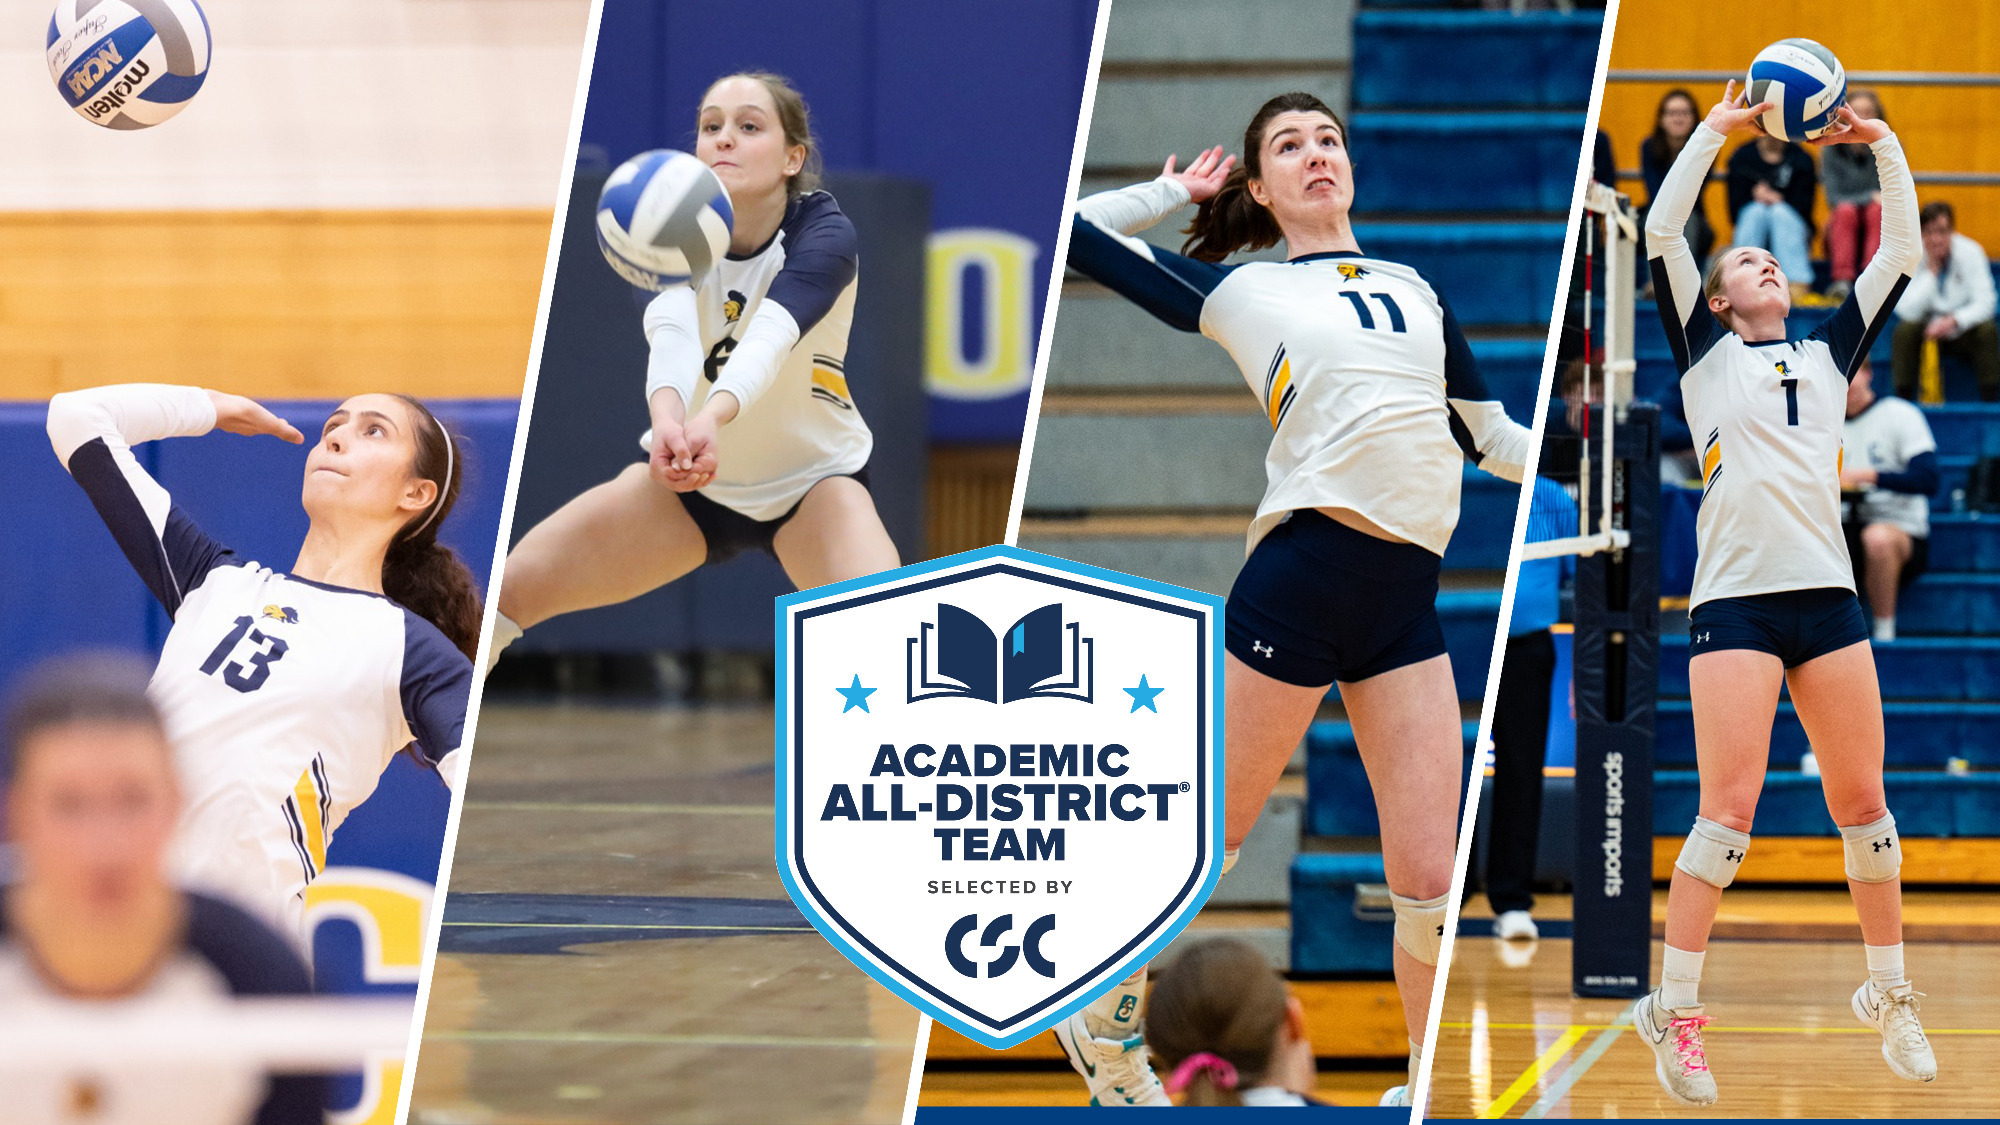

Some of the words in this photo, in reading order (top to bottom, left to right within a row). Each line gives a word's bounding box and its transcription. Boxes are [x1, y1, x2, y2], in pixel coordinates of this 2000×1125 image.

[66, 40, 123, 99] NCAA
[84, 58, 150, 119] molten
[1338, 291, 1407, 333] 11
[1780, 378, 1799, 426] 1
[199, 615, 290, 694] 13
[1603, 751, 1625, 816] sports
[1601, 817, 1625, 897] imports
